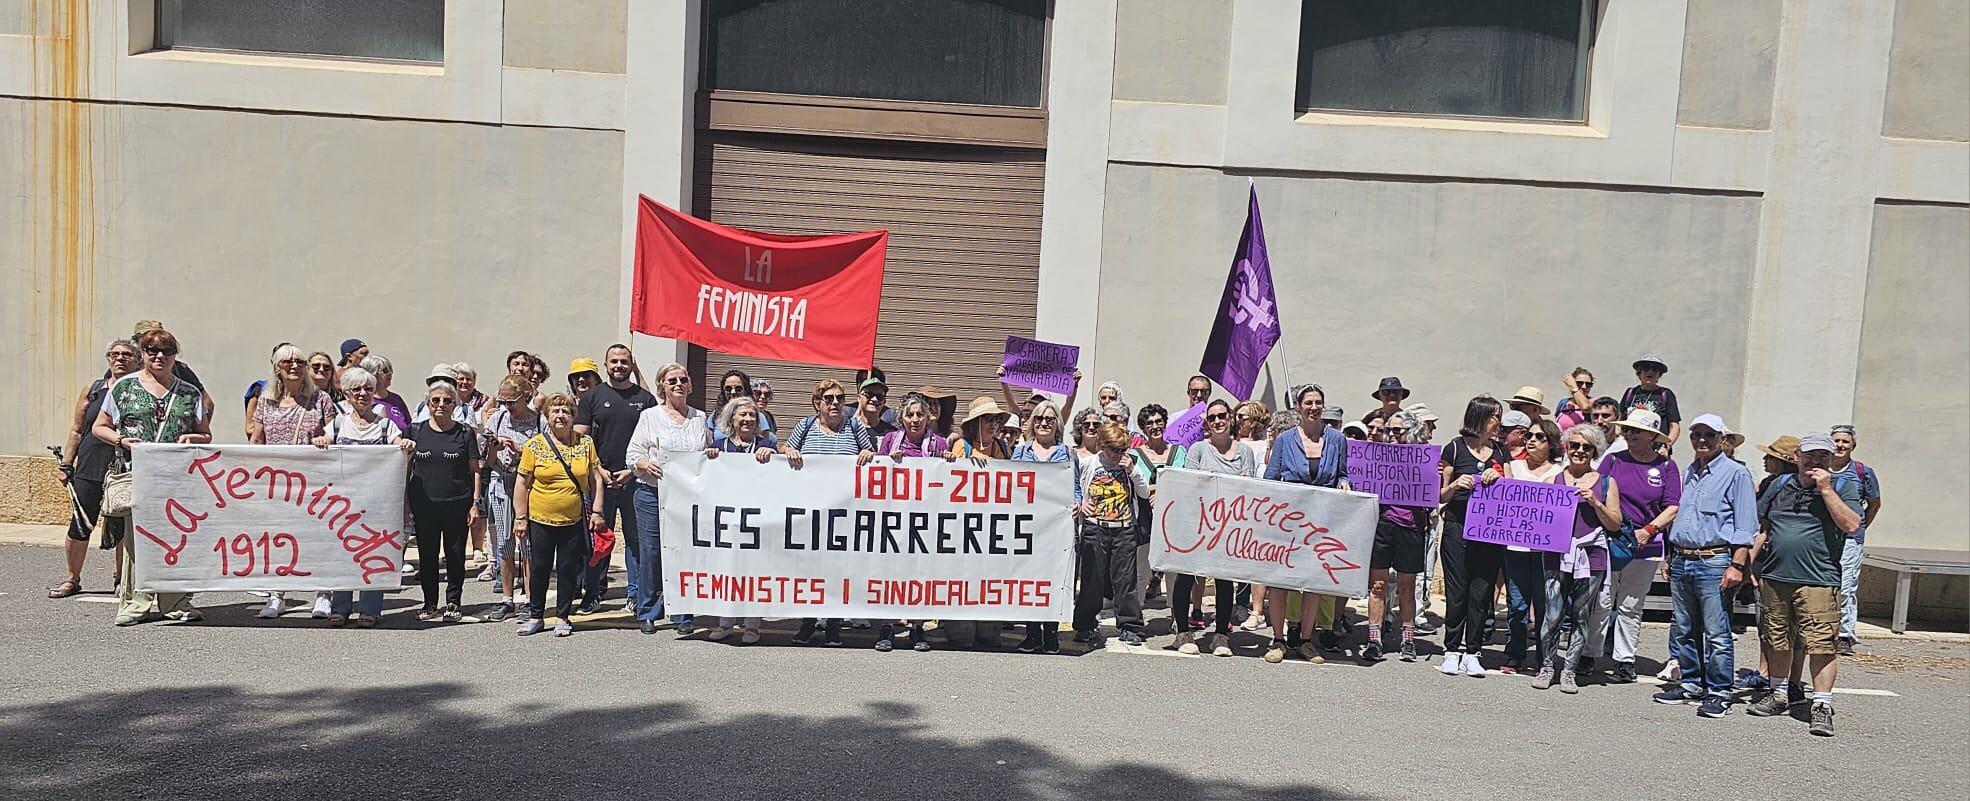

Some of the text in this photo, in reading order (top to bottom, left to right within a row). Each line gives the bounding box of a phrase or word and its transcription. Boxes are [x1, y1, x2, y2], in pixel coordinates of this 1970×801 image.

[744, 246, 773, 284] LA
[695, 283, 808, 340] FEMINISTA
[1008, 340, 1077, 366] CIGARRERAS
[1015, 358, 1073, 376] OBRERAS DE
[1006, 366, 1070, 392] VANGUARDIA
[1347, 441, 1432, 464] AS CIGARRERAS
[855, 465, 1036, 504] 1801-2009
[1348, 461, 1421, 482] SON HISTORIA
[135, 451, 401, 585] La Feminista
[1471, 502, 1554, 524] LA HISTORIA
[1486, 516, 1534, 531] DE LAS
[692, 505, 1033, 555] LES CIGARRERES
[1162, 494, 1361, 585] Cigarreras
[1467, 525, 1551, 546] CIGARRERAS
[213, 531, 312, 577] 1912
[680, 571, 1052, 608] FEMINISTES I SINDICALISTES
